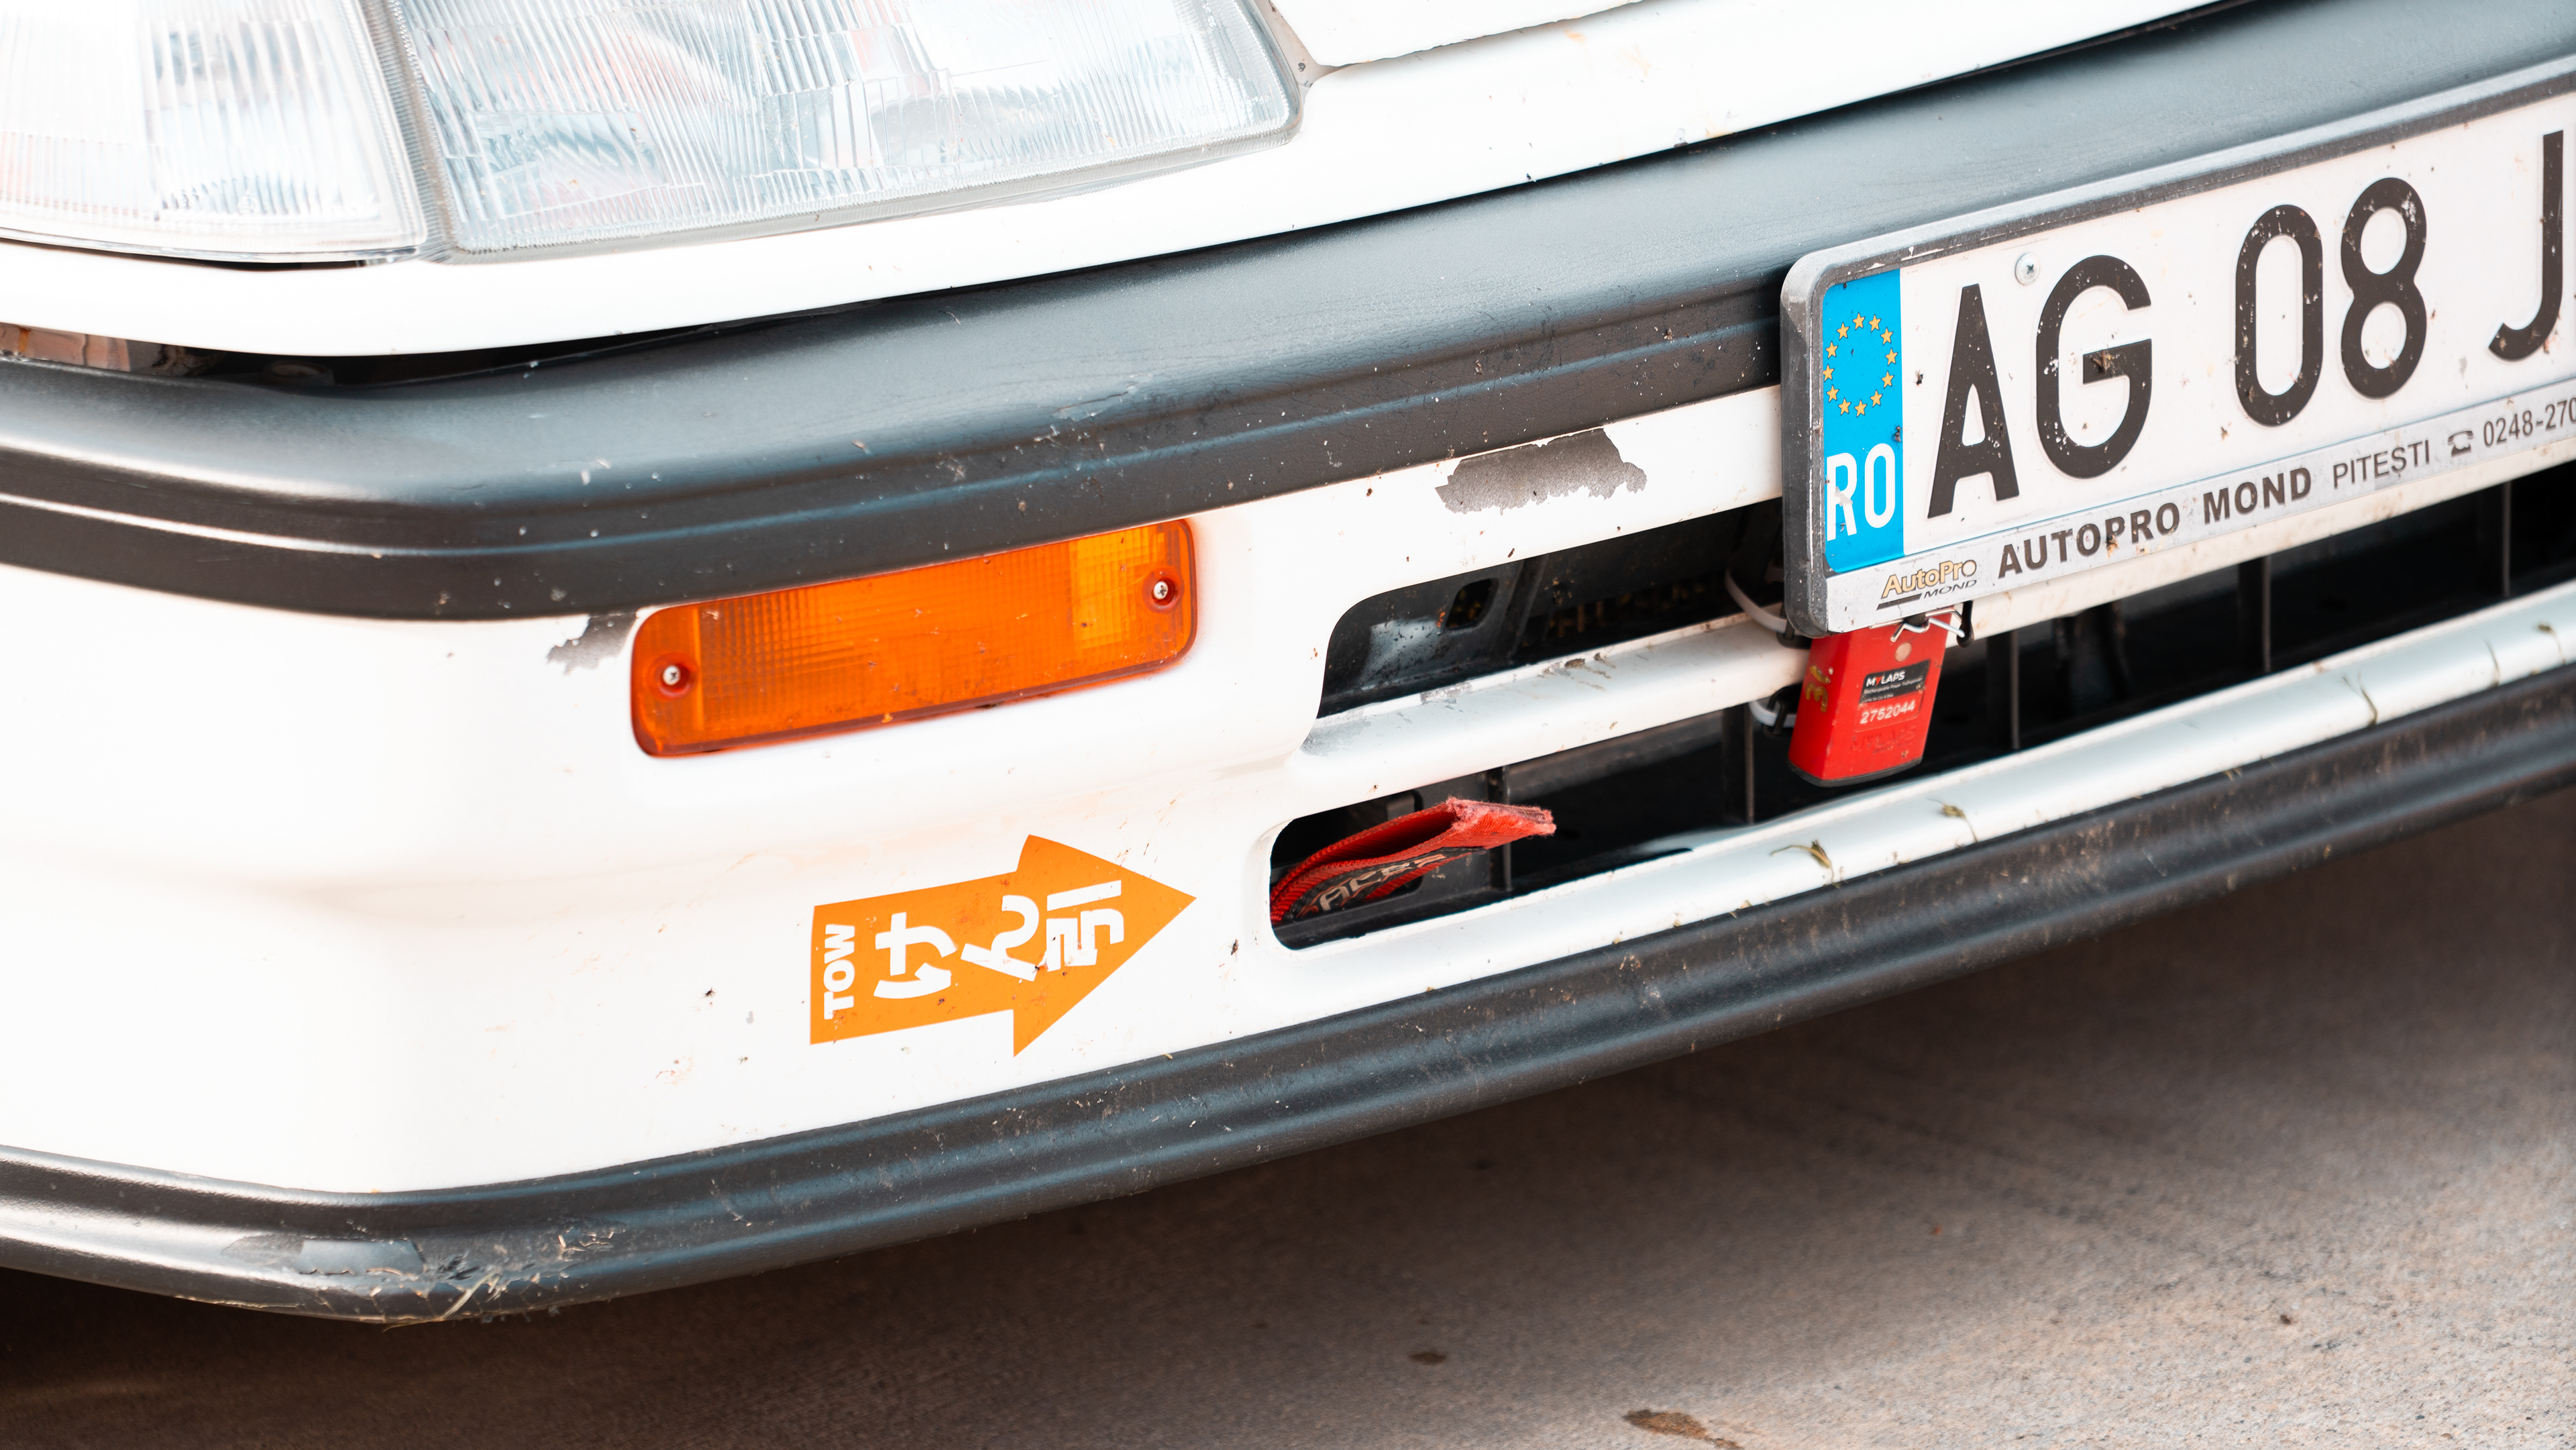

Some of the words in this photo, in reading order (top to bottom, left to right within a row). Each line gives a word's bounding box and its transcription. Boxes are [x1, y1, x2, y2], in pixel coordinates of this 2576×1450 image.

[1927, 254, 2152, 519] AG
[2235, 177, 2427, 427] 08
[2487, 130, 2564, 361] J
[1826, 443, 1896, 541] RO
[1997, 502, 2180, 580] AUTOPRO
[2203, 467, 2312, 525] MOND
[1880, 560, 1977, 599] AutoPro
[1924, 580, 1977, 599] MOND
[1860, 700, 1917, 724] 2752044
[1866, 670, 1905, 687] MYLAPS
[824, 924, 855, 1020] TOW
[873, 880, 1125, 1000] けん引
